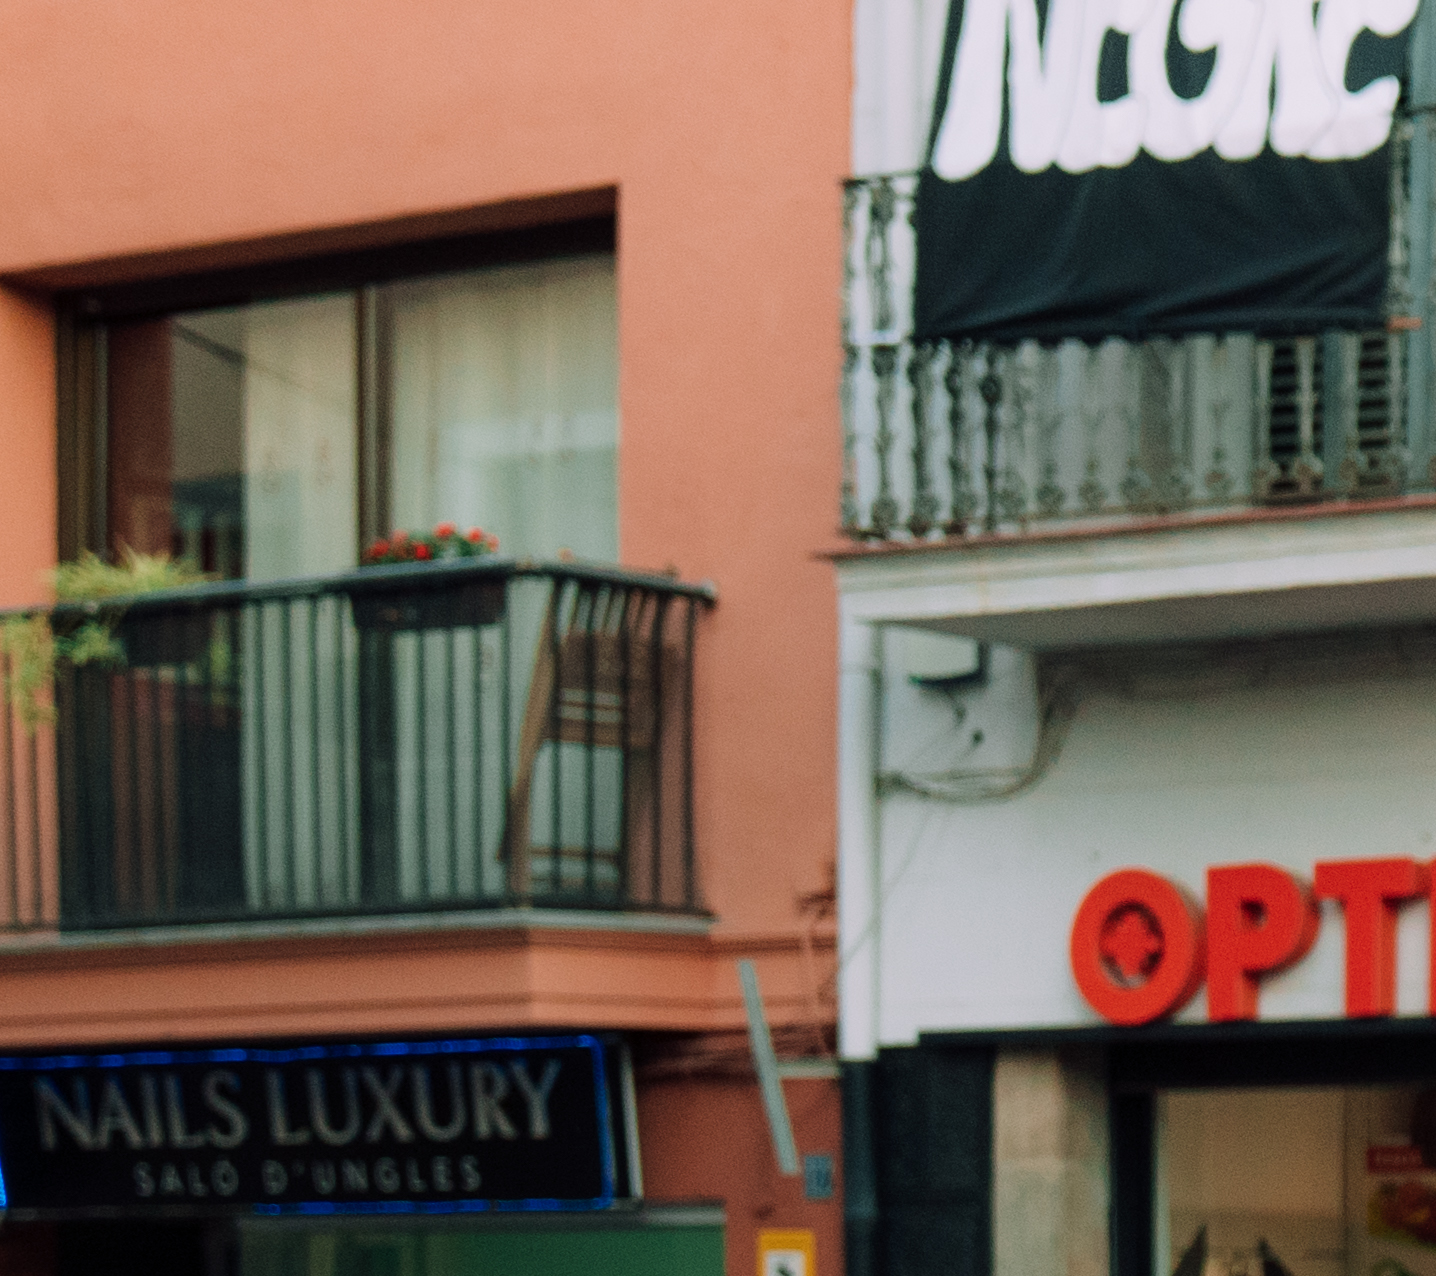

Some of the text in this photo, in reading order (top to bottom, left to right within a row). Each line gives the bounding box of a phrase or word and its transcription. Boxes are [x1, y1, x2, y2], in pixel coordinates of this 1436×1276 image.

[32, 1057, 563, 1153] NAILS LUXURY
[261, 1154, 484, 1197] D'UNGLES
